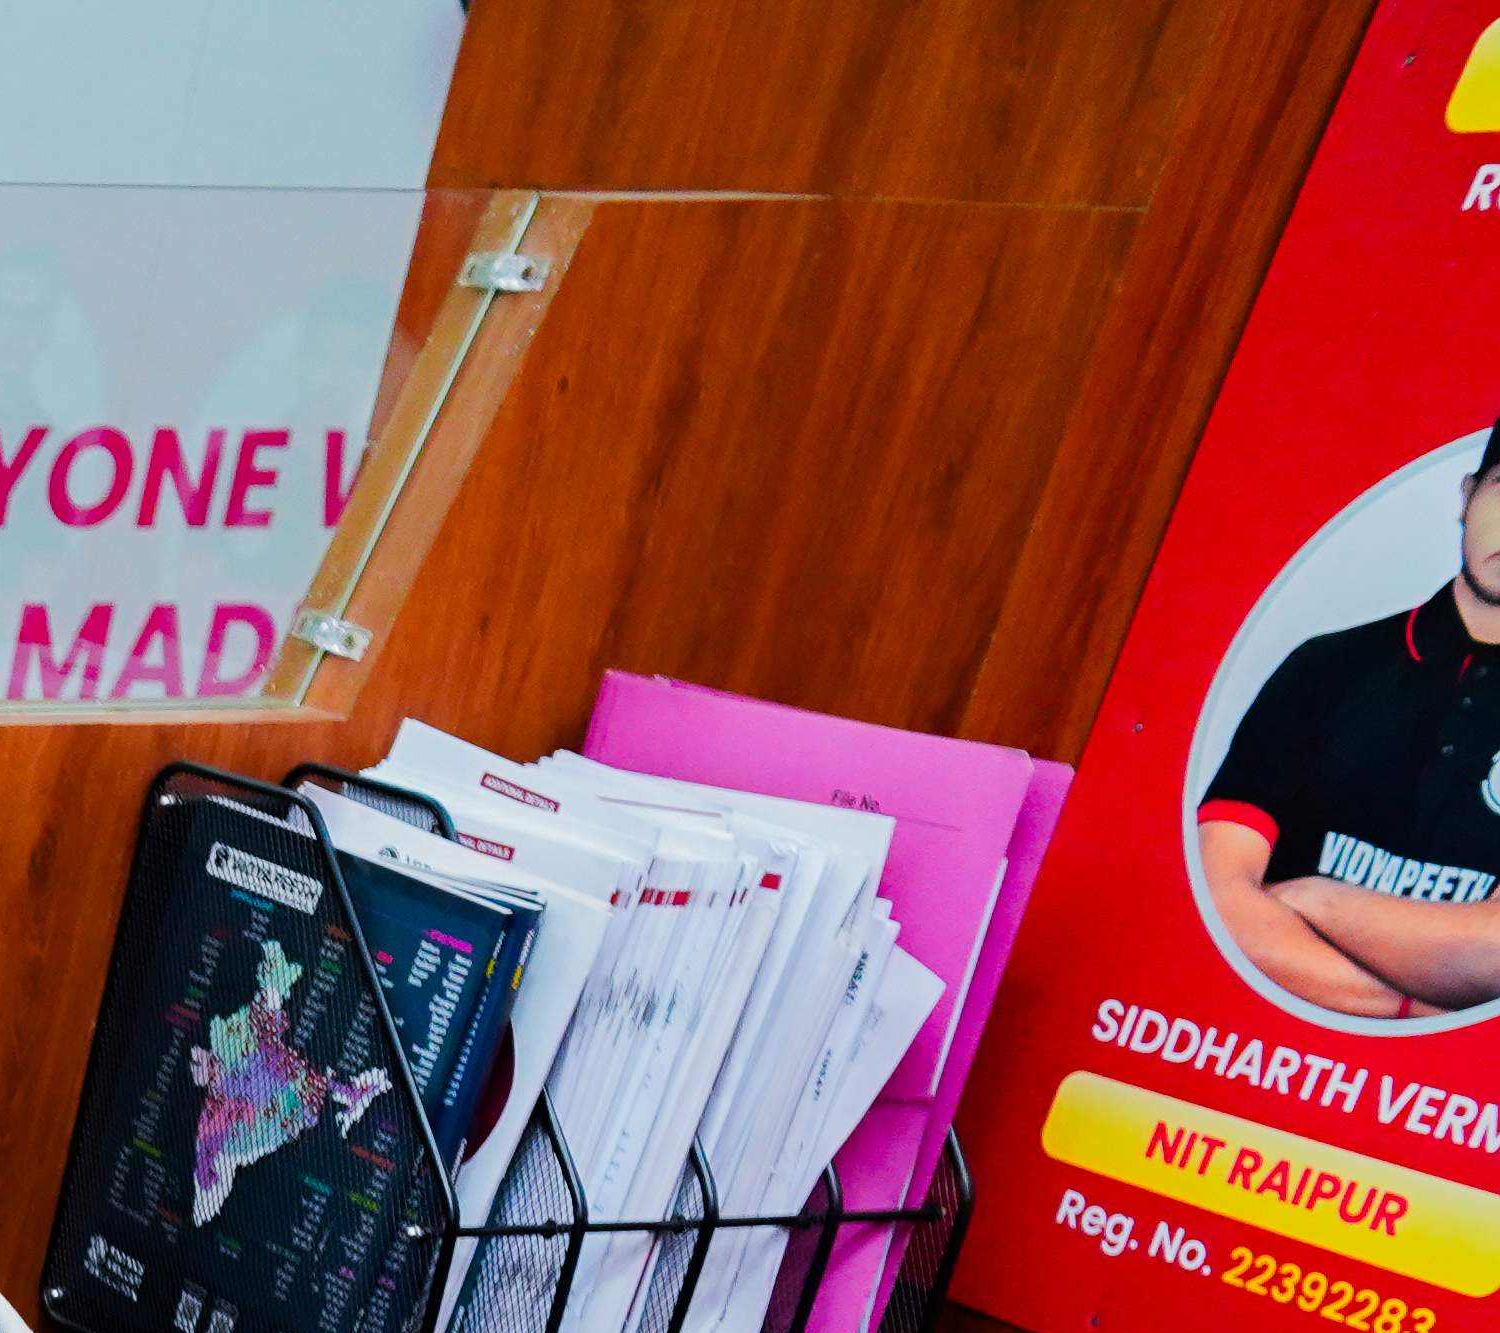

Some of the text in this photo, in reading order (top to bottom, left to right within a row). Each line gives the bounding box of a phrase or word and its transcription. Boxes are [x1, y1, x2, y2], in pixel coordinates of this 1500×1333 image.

[1091, 998, 1369, 1115] SIDDHARTH
[1055, 1188, 1140, 1258] Reg.
[1148, 1220, 1213, 1277] No.
[1145, 1119, 1409, 1238] NIT RAIPUR
